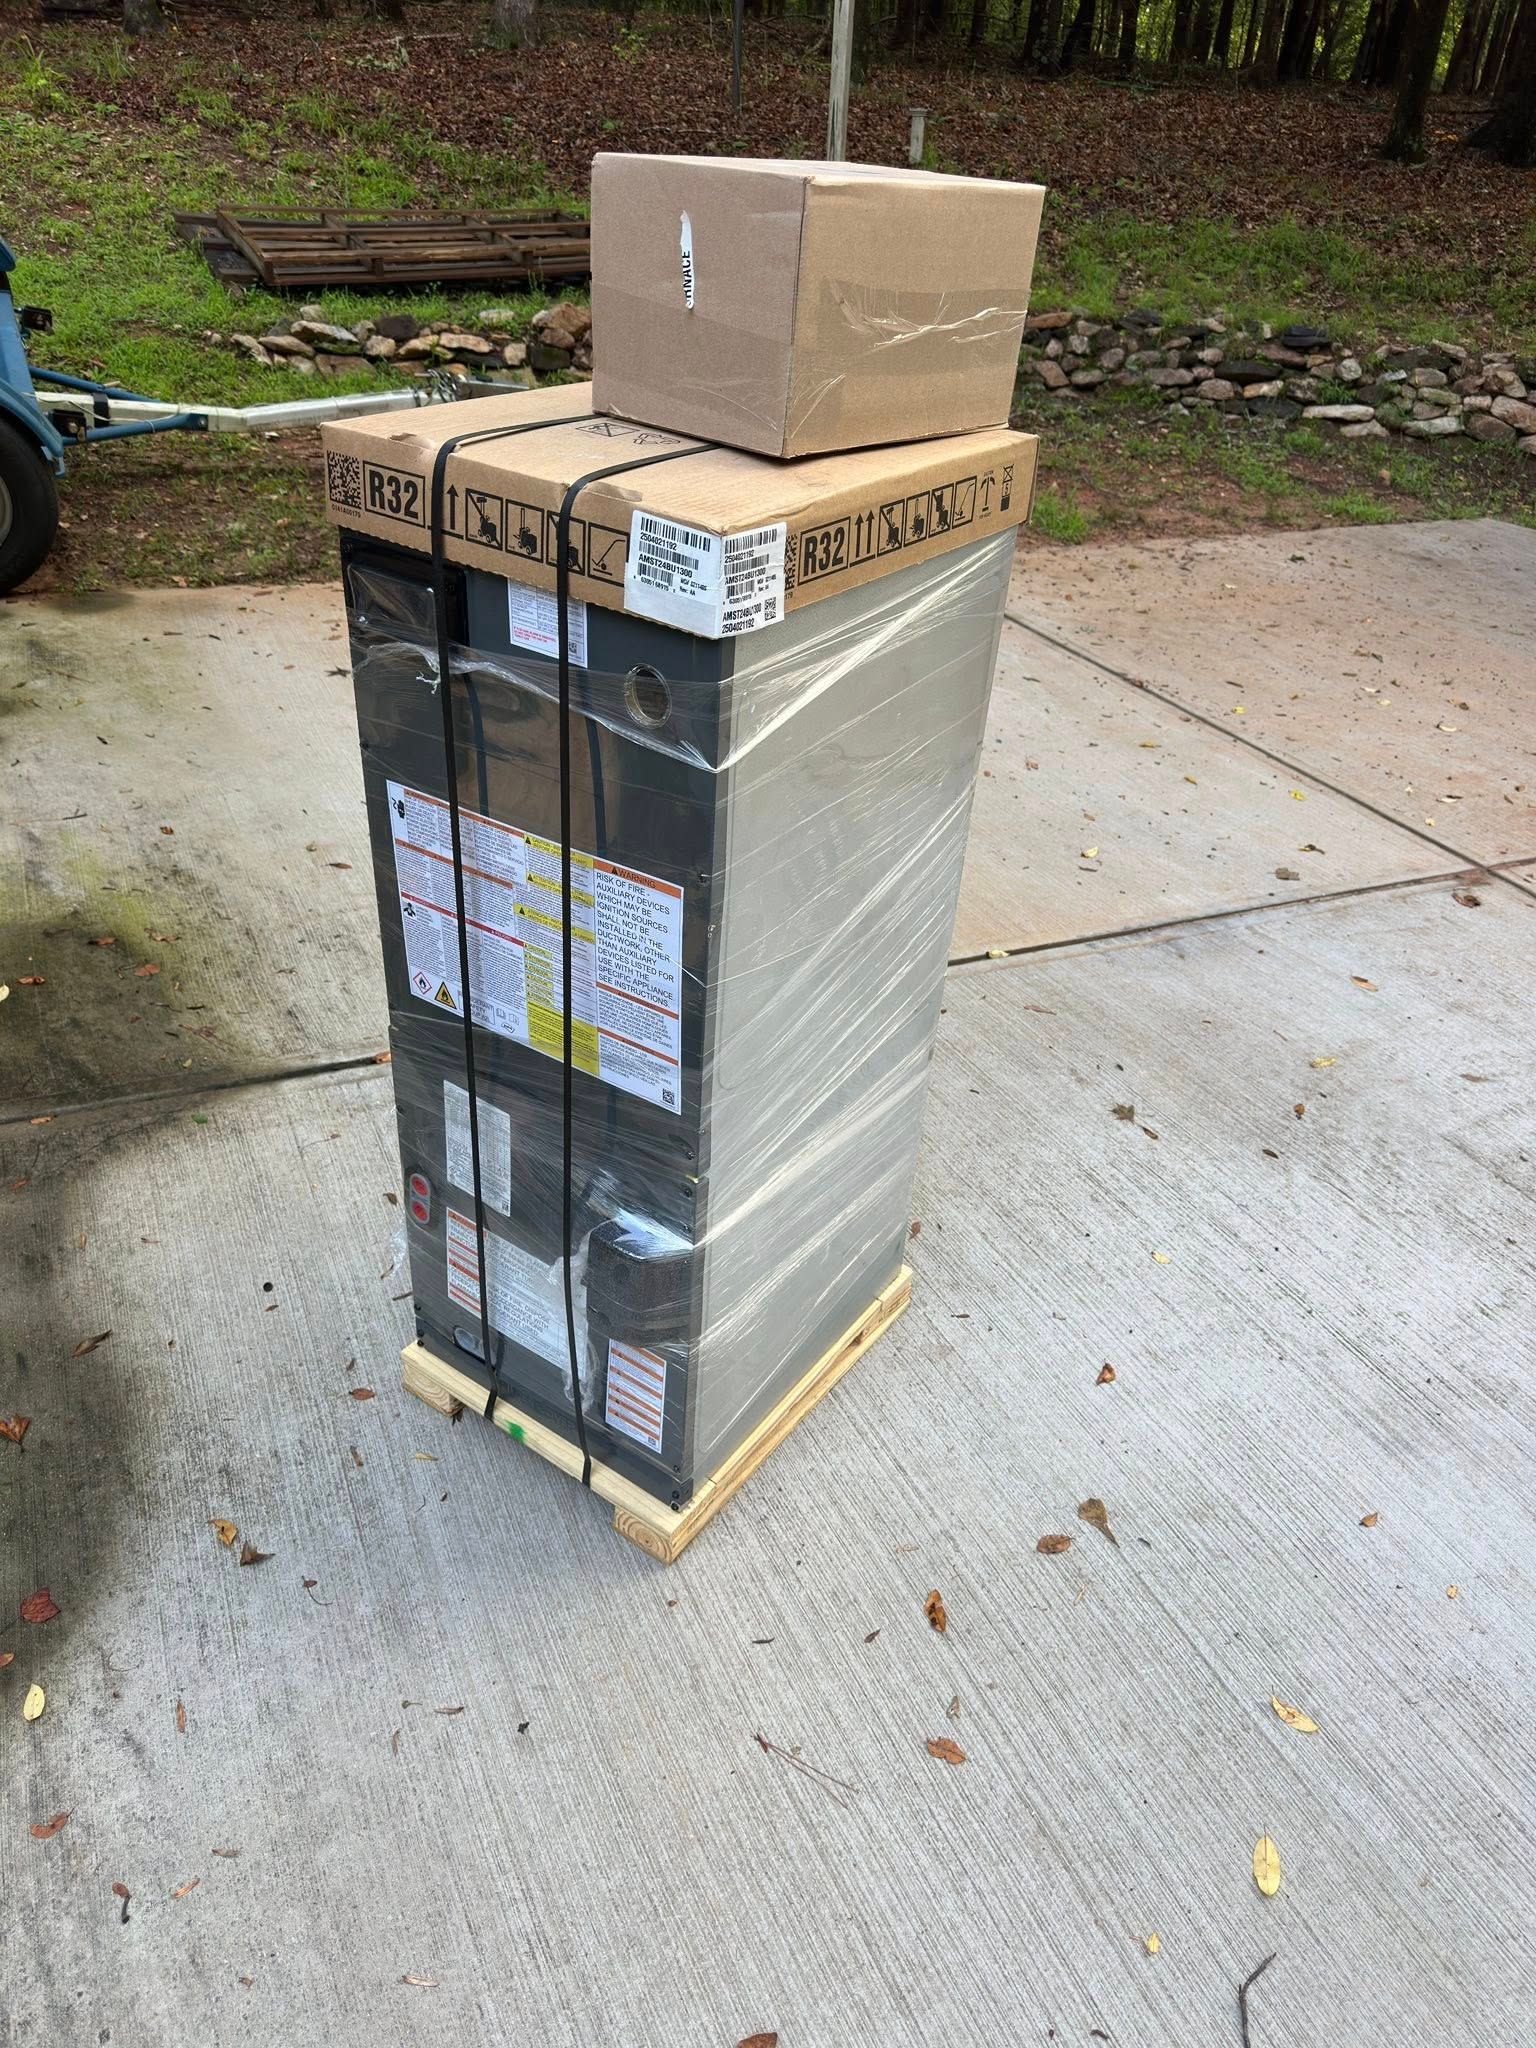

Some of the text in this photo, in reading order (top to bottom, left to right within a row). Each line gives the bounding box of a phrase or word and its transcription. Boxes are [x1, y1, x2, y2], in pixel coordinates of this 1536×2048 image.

[369, 469, 419, 519] R32
[640, 533, 677, 551] 2504021192
[804, 527, 845, 577] R32
[638, 554, 692, 578] AMST24BU1300
[724, 549, 754, 564] 2504021192
[722, 618, 754, 634] 2504021192
[596, 872, 613, 884] RISK
[615, 879, 625, 888] OF
[628, 883, 645, 896] FIRE
[619, 869, 655, 888] WARNING
[596, 881, 634, 902] AUXILIARY
[637, 895, 669, 915] DEVICES
[596, 891, 651, 917] WHICH MAY BE
[597, 900, 629, 918] IGNITION
[631, 913, 667, 933] SOURCES
[597, 910, 649, 936] SHALL NOT BE
[597, 919, 636, 940] INSTALLED
[649, 939, 663, 950] THE
[597, 946, 673, 982] DEVICES LISTED FOR
[598, 938, 656, 966] THAN AUXILIARY
[644, 946, 669, 962] OTHER
[598, 955, 649, 981] USE WITH THE
[598, 973, 612, 984] SEE
[598, 964, 630, 983] SPECIFIC
[632, 978, 672, 1000] APPLIANCE
